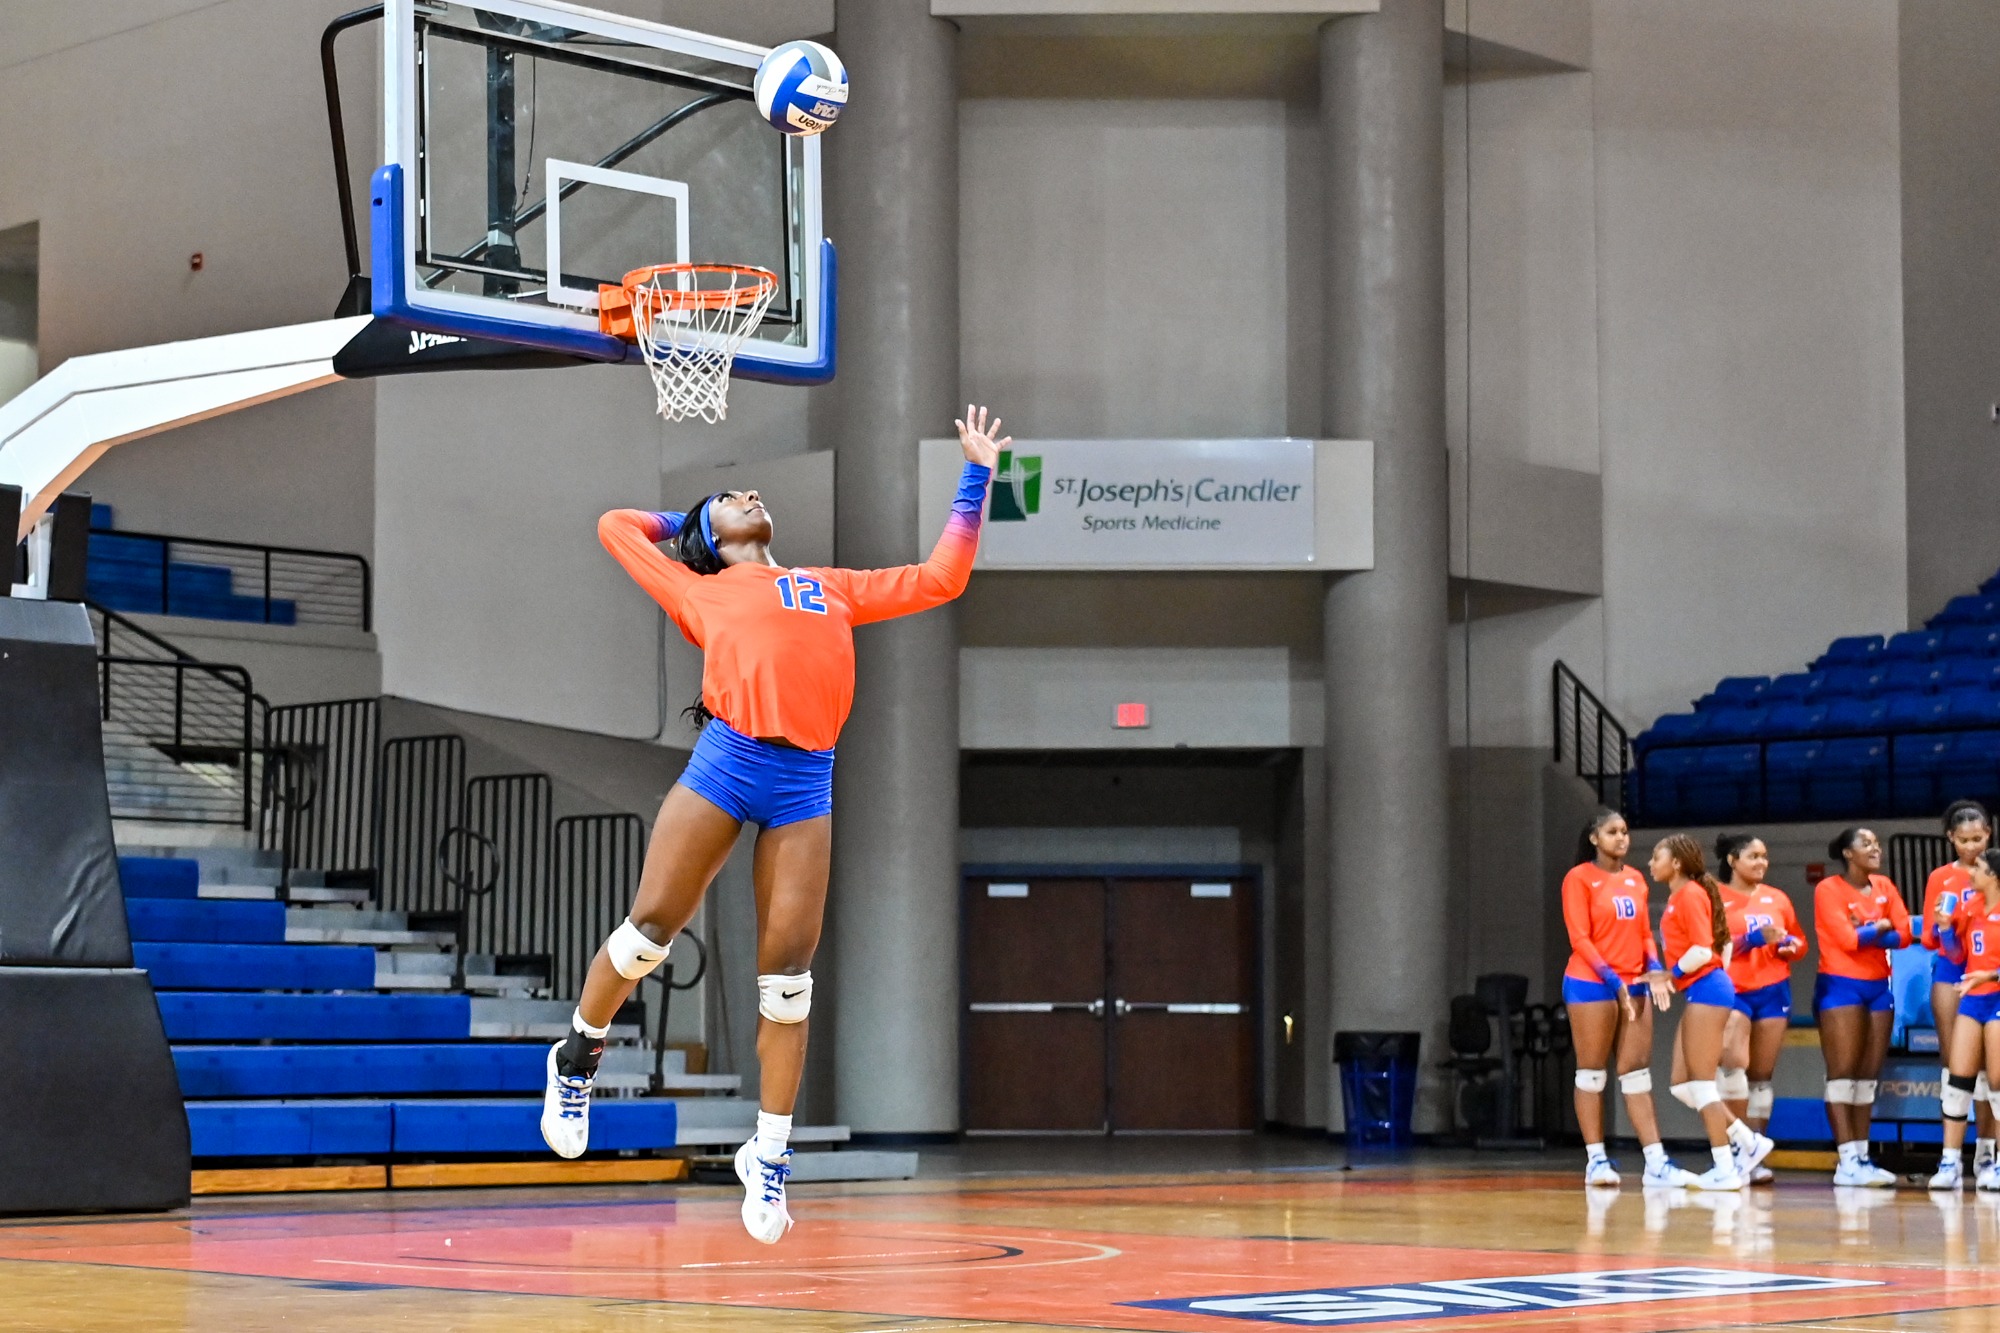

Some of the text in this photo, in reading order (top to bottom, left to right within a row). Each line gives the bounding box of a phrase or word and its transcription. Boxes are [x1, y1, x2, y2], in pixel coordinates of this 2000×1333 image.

[798, 115, 828, 131] olten
[1053, 478, 1078, 495] ST.
[1194, 478, 1301, 503] Candler
[1082, 515, 1222, 534] Sports Medicine
[774, 573, 828, 616] 12
[1612, 895, 1637, 921] 18
[1971, 930, 1986, 956] 6
